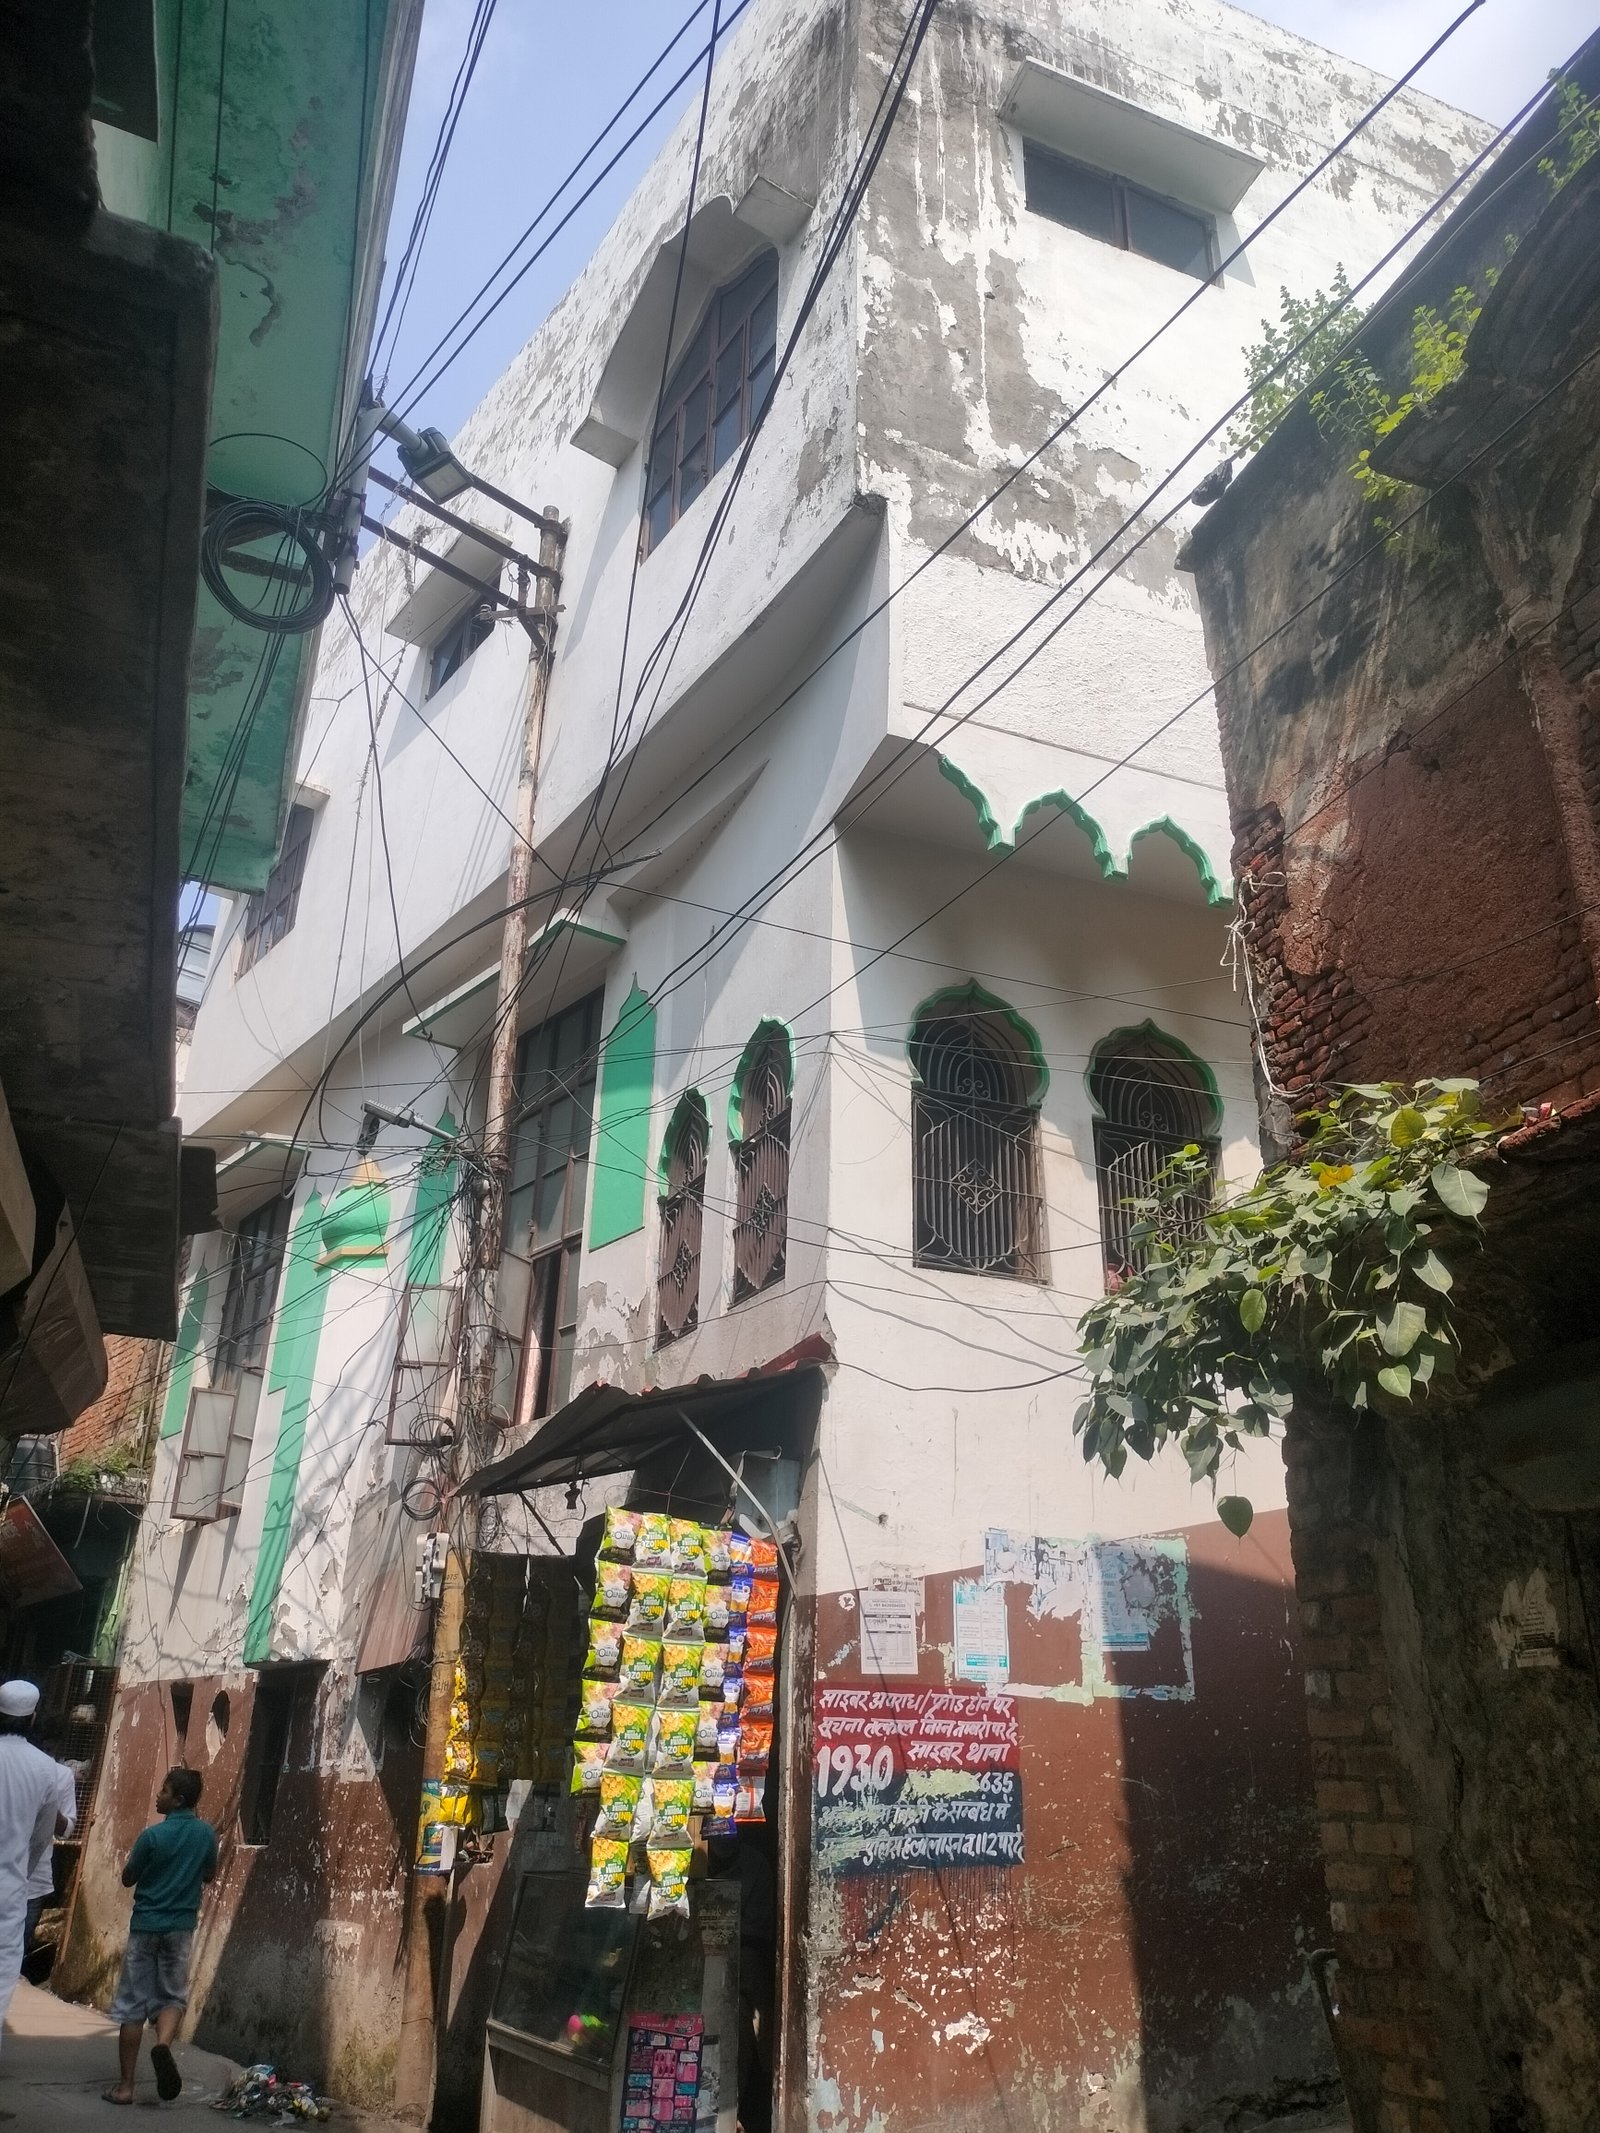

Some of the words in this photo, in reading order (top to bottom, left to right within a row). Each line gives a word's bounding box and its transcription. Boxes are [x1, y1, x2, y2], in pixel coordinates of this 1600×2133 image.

[907, 1741, 964, 1765] साइबर
[965, 1743, 1010, 1763] थाना
[817, 1744, 894, 1798] 1930
[995, 1795, 1013, 1820] में
[976, 1832, 998, 1857] 112
